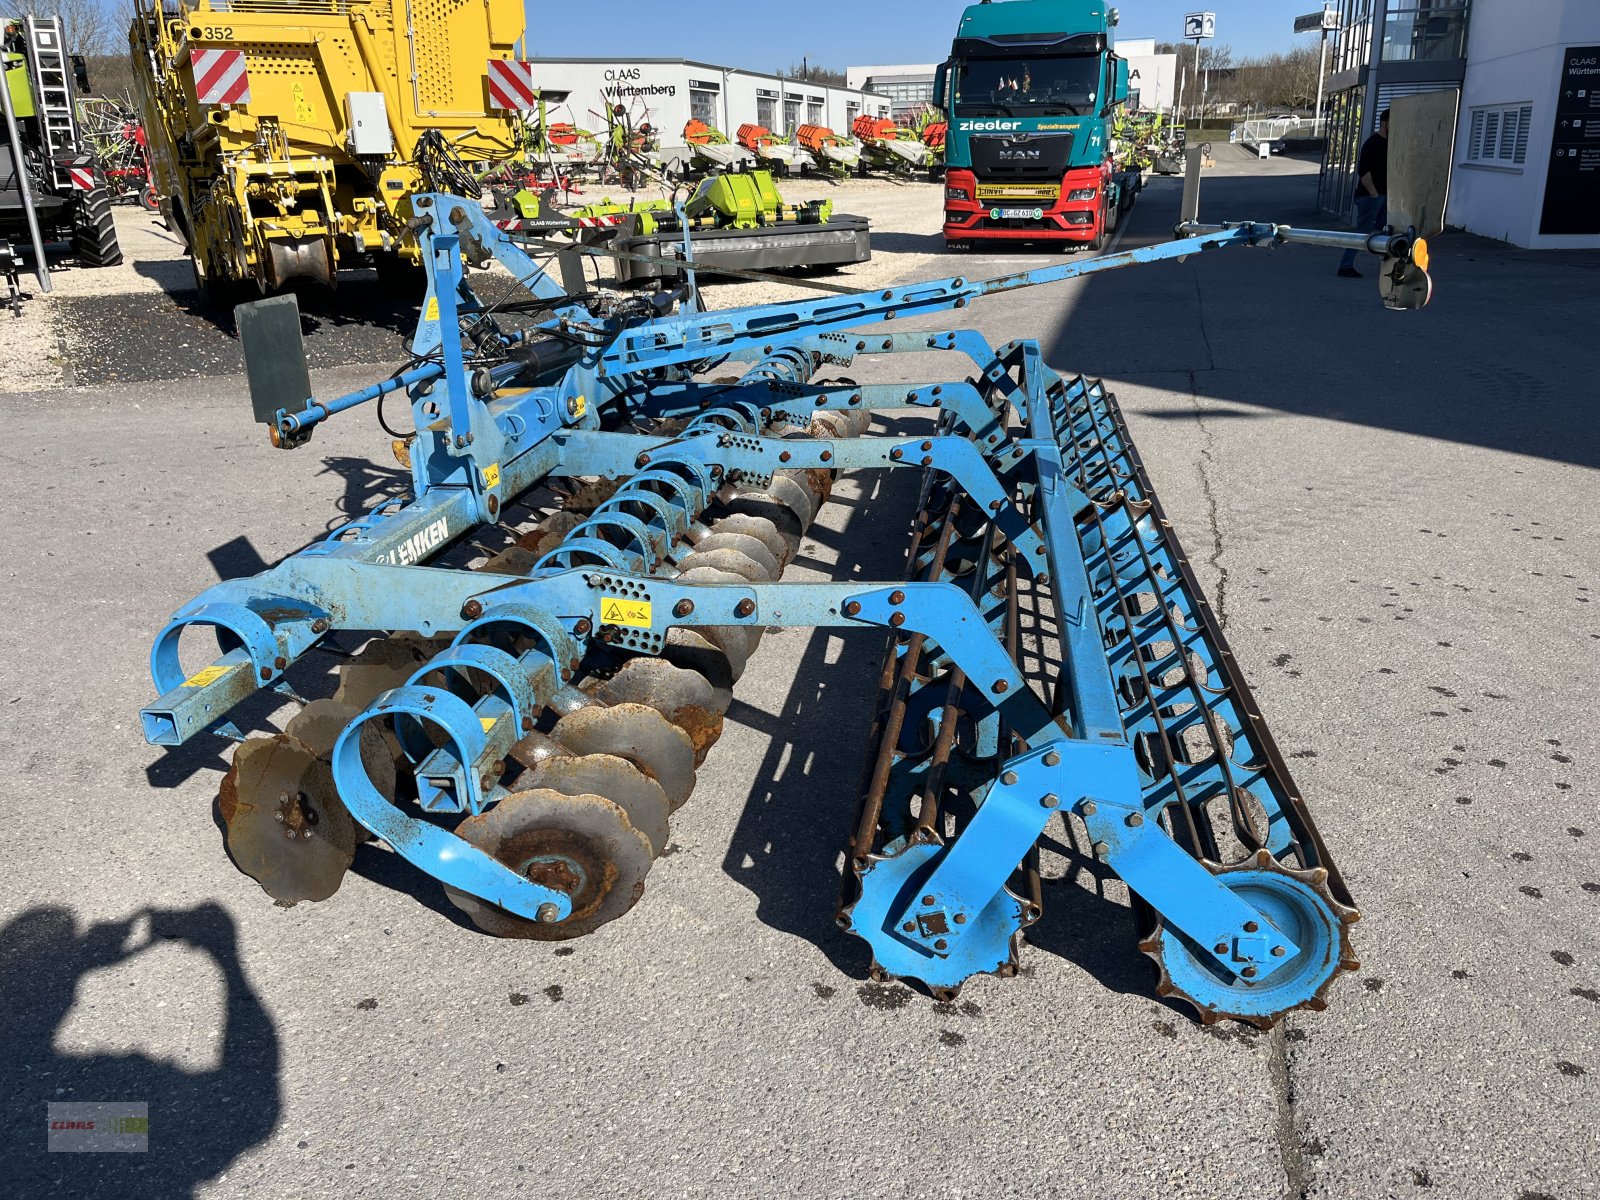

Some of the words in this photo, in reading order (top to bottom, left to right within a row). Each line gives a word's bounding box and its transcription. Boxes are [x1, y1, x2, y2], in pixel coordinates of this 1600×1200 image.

[204, 27, 234, 40] 352
[1570, 57, 1597, 66] CLAAS
[604, 68, 641, 81] CLAAS
[605, 84, 676, 97] Württemberg
[959, 120, 1022, 131] ziegler
[1037, 123, 1081, 131] Spezialtransport
[1091, 136, 1101, 146] 71
[999, 150, 1040, 160] MAN
